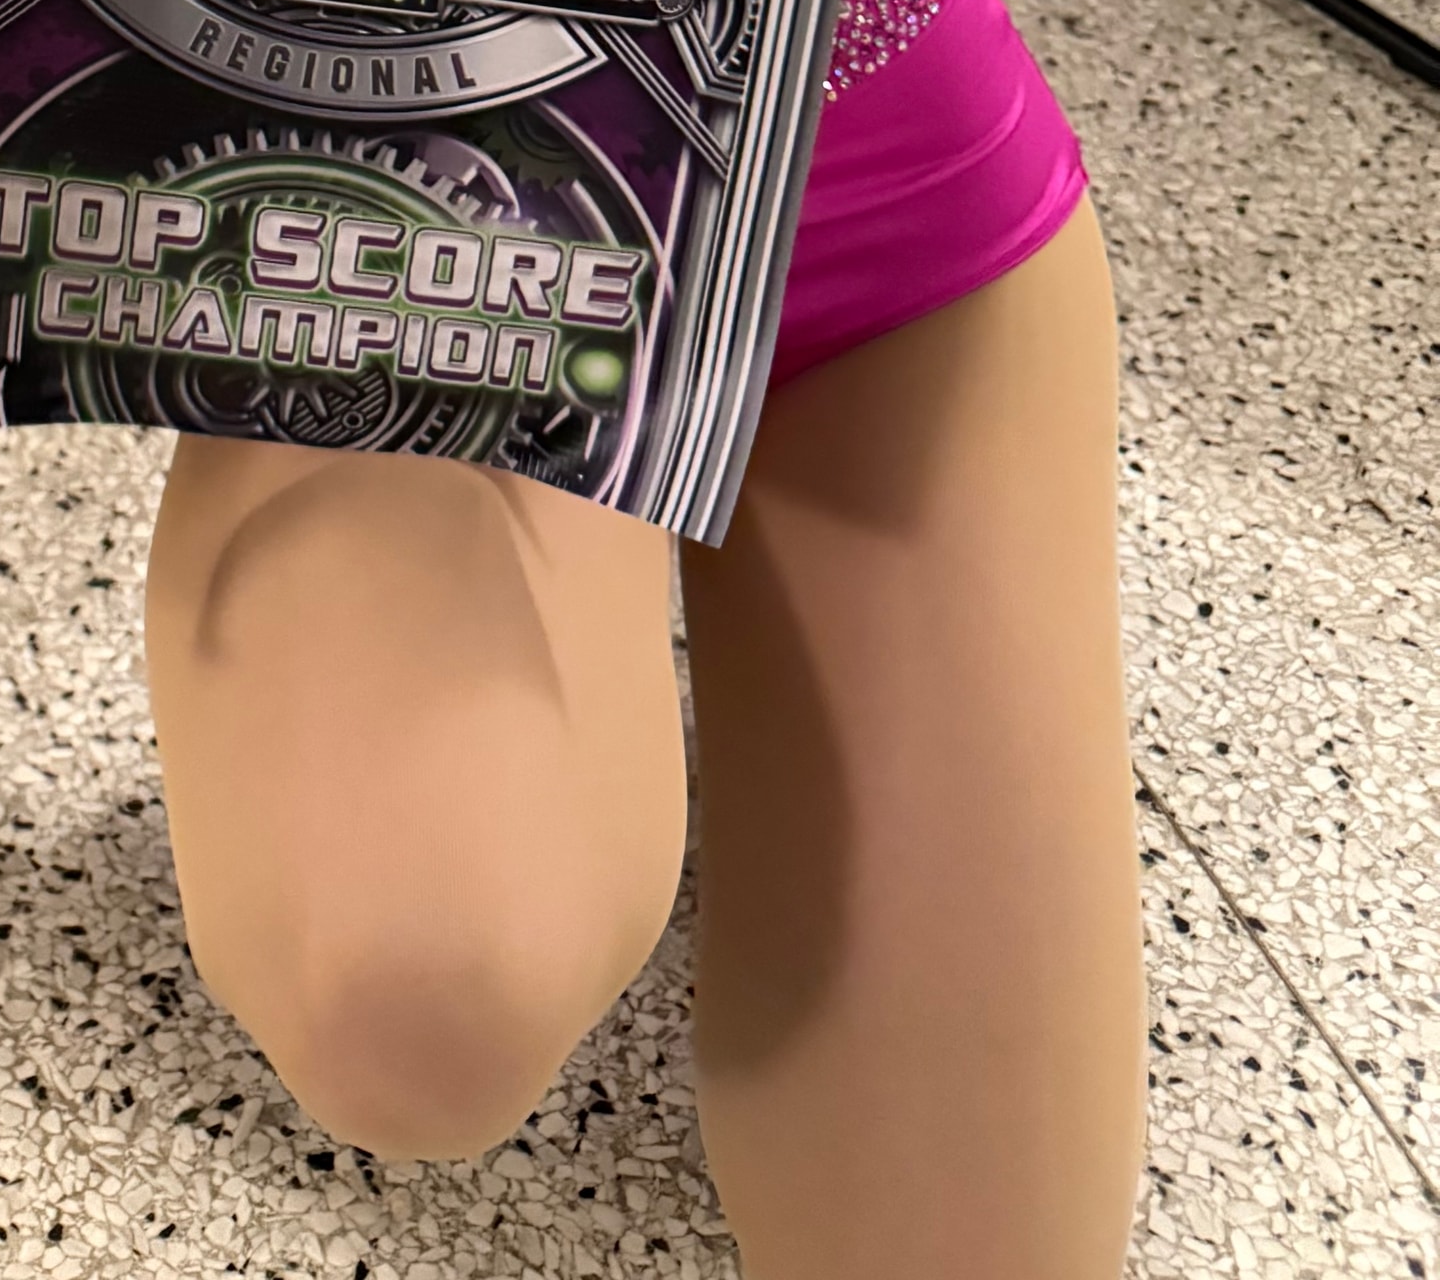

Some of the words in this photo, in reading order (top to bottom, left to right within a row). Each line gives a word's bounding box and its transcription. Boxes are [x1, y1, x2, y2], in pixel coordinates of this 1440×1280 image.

[188, 18, 477, 96] REGIONAL
[250, 204, 647, 327] SCORE
[38, 268, 558, 391] CHAMPION
